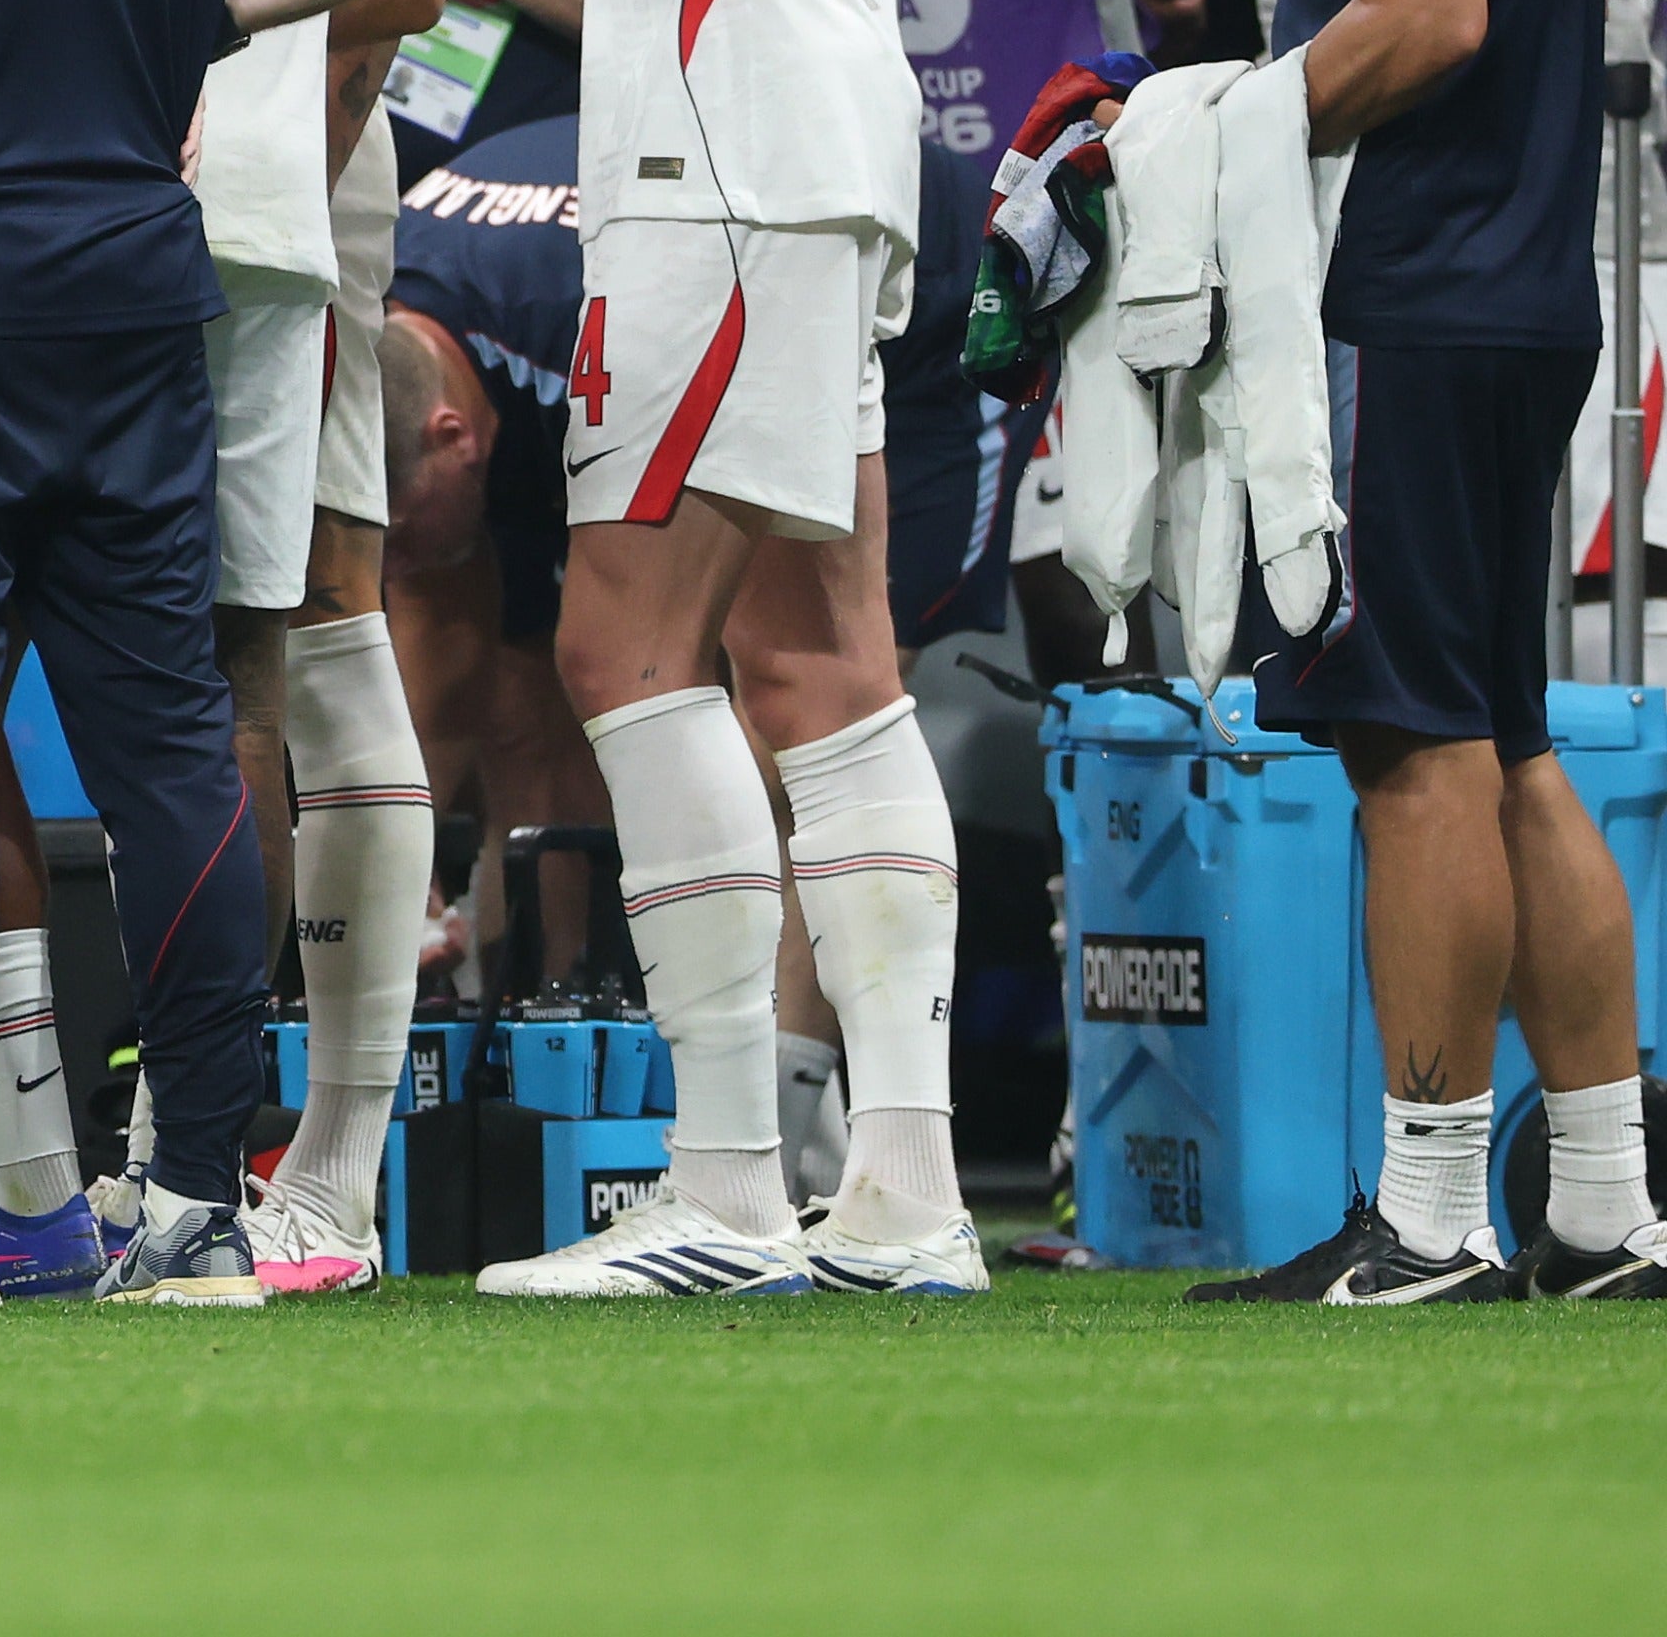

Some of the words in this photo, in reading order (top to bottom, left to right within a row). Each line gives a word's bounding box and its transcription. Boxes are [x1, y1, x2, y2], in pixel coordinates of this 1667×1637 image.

[920, 67, 985, 100] CUP
[402, 167, 580, 230] ENGLAN
[570, 295, 611, 426] 4
[1107, 799, 1141, 842] ENG
[297, 918, 346, 943] ENG
[1082, 945, 1203, 1013] POWERADE
[545, 1037, 566, 1052] 12
